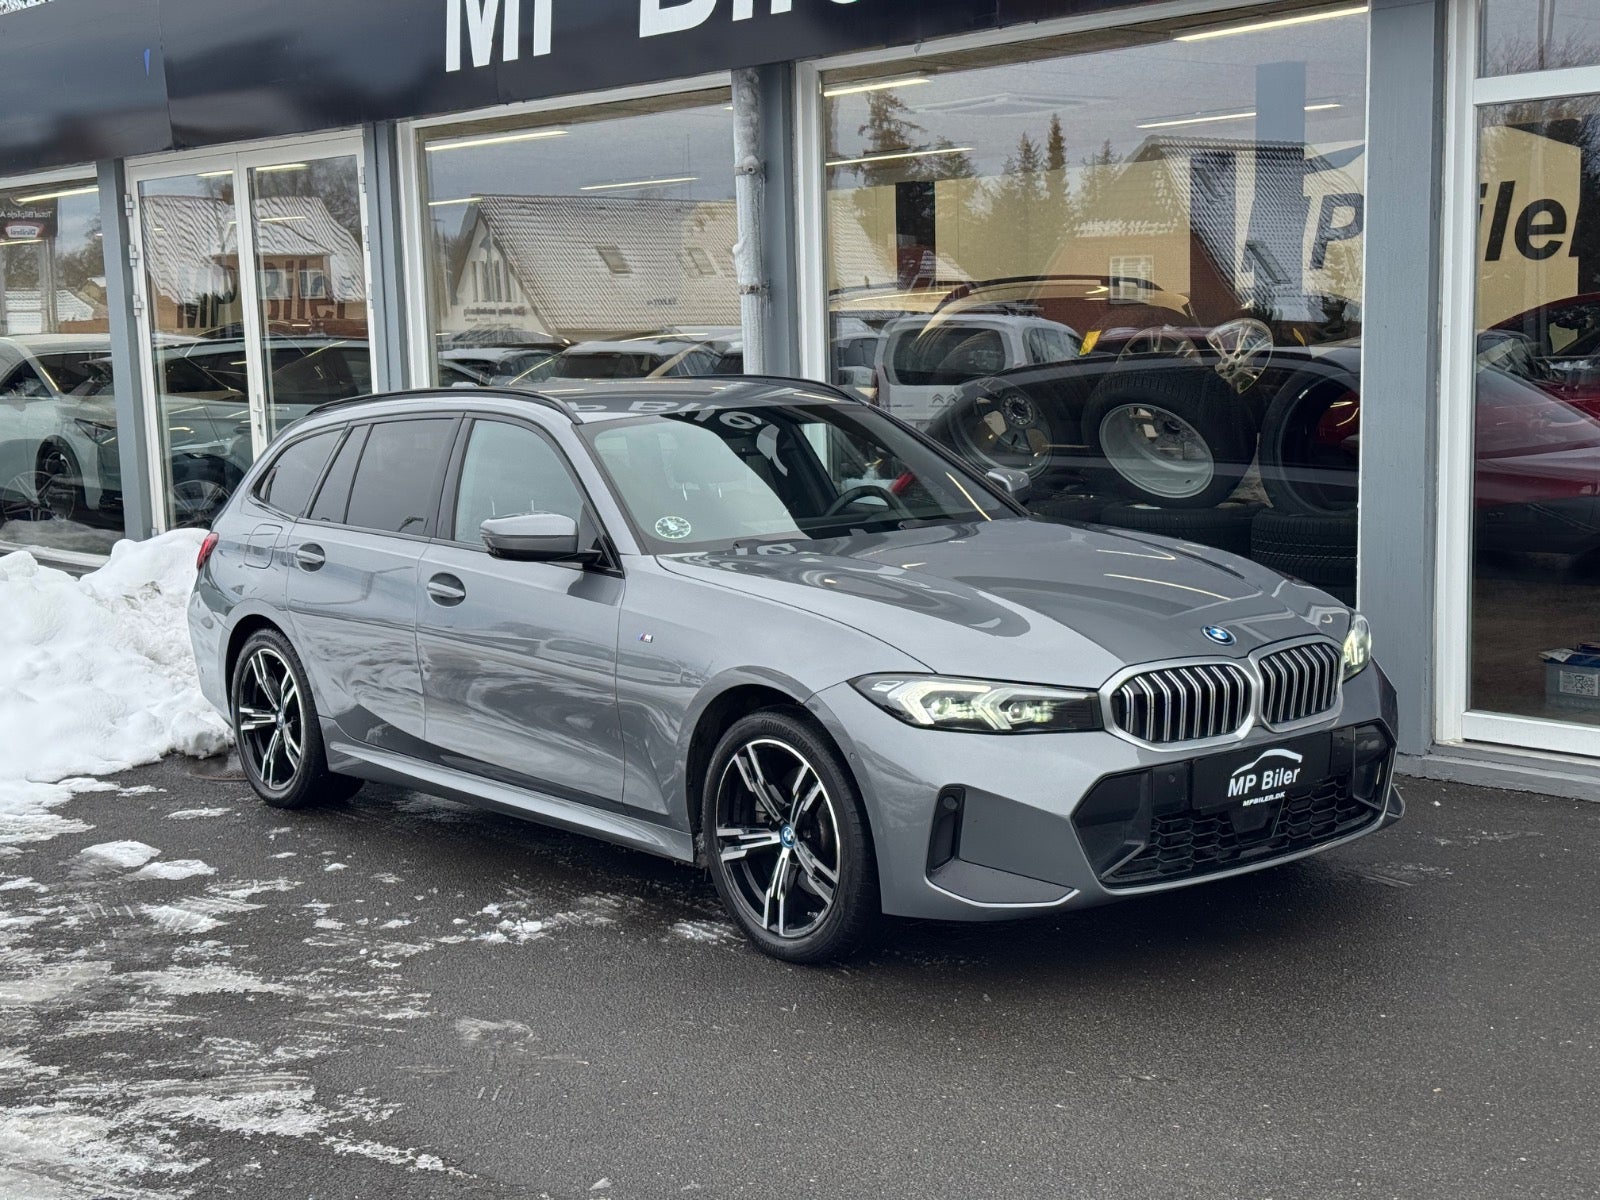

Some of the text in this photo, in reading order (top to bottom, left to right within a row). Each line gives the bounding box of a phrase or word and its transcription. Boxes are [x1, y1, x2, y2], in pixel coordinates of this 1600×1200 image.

[1227, 767, 1301, 798] MP Biler
[1242, 790, 1286, 807] MPBILER.DK
